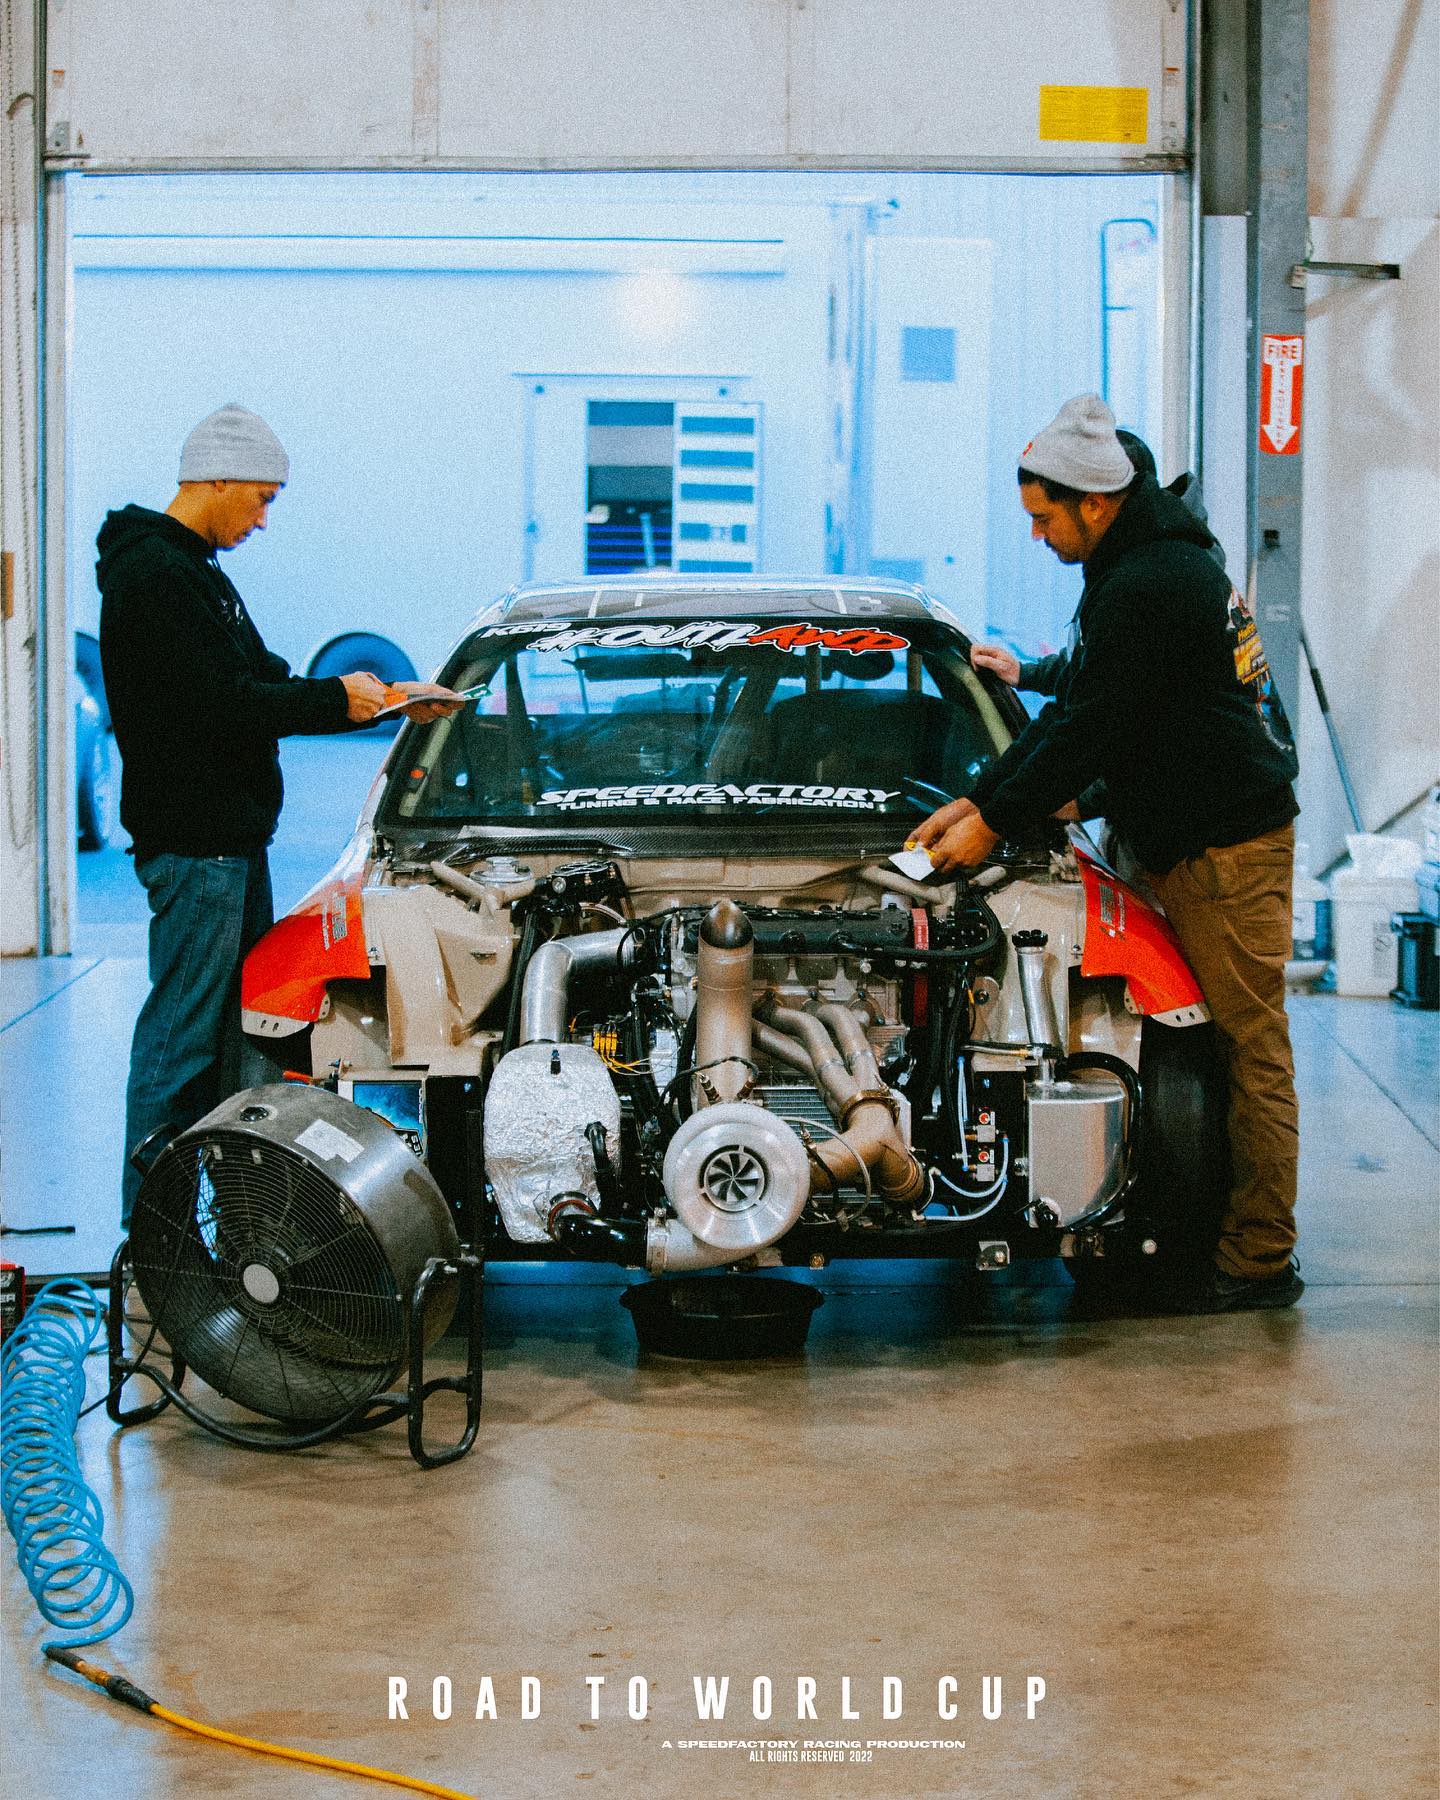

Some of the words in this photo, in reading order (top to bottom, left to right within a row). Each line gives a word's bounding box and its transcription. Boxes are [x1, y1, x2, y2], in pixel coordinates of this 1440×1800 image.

[1268, 344, 1298, 359] FIRE
[536, 784, 901, 806] SPEEDFACTORY
[557, 798, 637, 811] TUNING
[643, 798, 660, 806] &
[667, 796, 727, 806] RACE
[733, 796, 875, 810] FABRICATION
